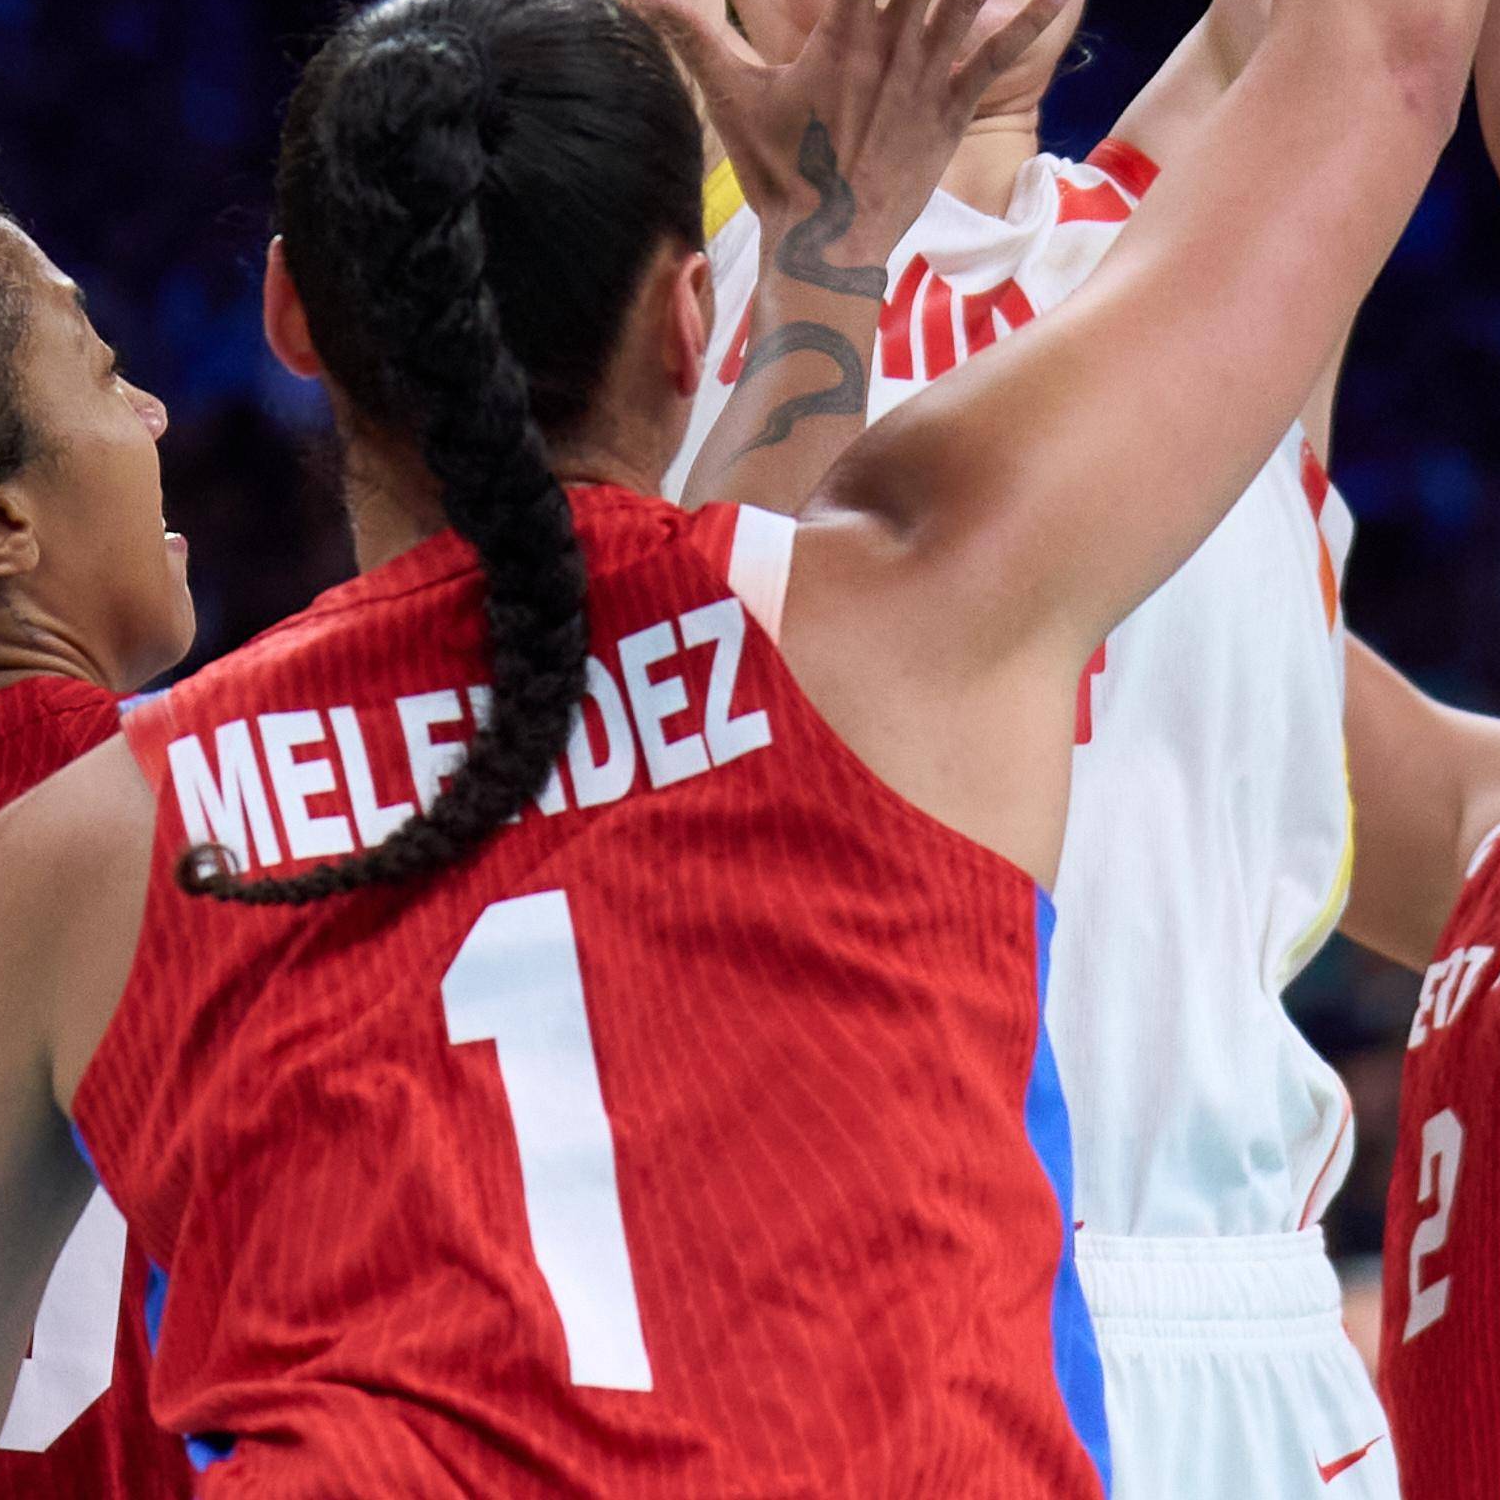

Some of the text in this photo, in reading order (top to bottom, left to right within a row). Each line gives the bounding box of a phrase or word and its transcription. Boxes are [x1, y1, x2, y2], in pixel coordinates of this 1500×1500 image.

[167, 597, 772, 879] MELEDEZ
[441, 889, 653, 1391] 1
[1402, 1106, 1463, 1343] 2
